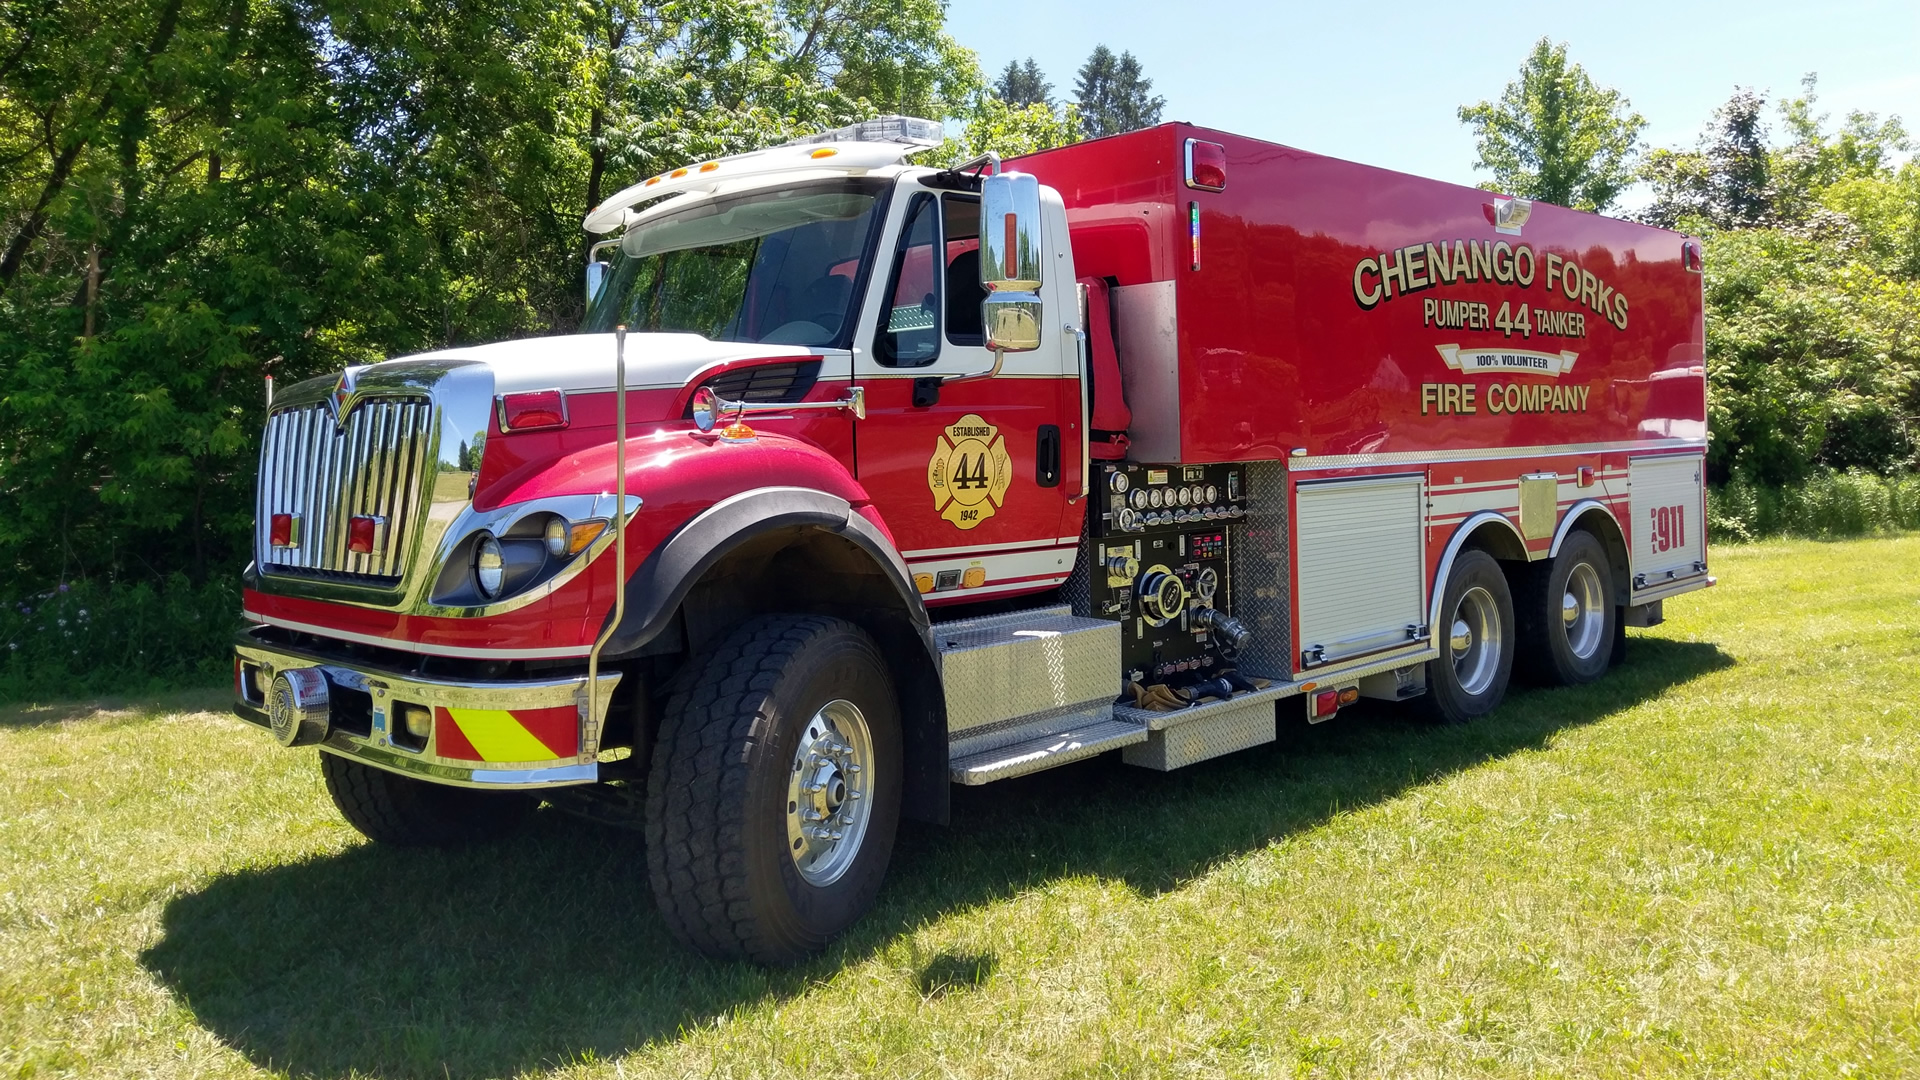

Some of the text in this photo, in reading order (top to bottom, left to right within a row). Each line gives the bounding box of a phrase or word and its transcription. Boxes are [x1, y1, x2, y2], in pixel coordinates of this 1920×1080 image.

[1353, 239, 1629, 330] CHENANGO FORKS
[1424, 298, 1585, 337] PUMPER 44 TANKER
[1476, 355, 1548, 369] 100% VOLUNTEER
[1421, 383, 1590, 414] FIRE COMPANY
[953, 427, 990, 437] ESTABLISHED
[952, 453, 988, 489] 44
[960, 510, 979, 521] 1942
[1650, 508, 1658, 554] DIAL
[1658, 505, 1684, 552] 911
